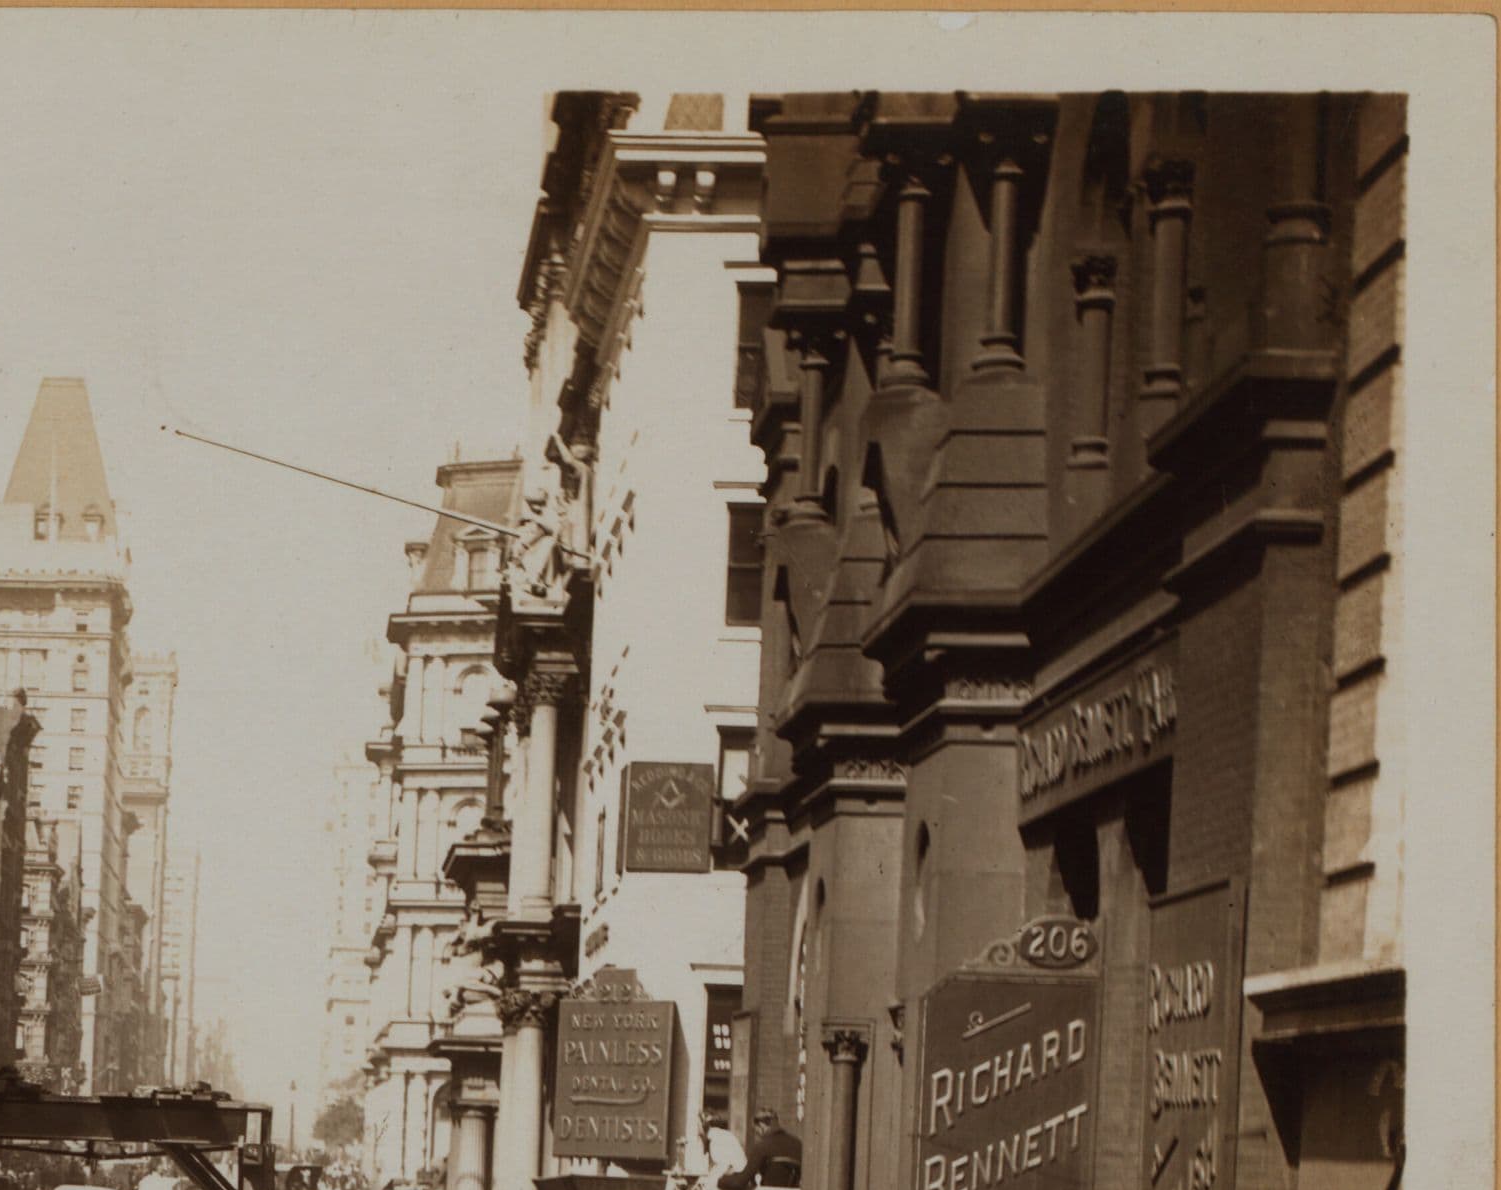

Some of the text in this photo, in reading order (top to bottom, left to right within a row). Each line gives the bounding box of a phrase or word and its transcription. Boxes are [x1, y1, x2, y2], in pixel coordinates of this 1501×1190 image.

[1028, 925, 1088, 959] 206
[572, 1013, 660, 1031] NEW YORK
[564, 1039, 663, 1065] PAINLESS
[929, 1018, 1088, 1137] RICHARD
